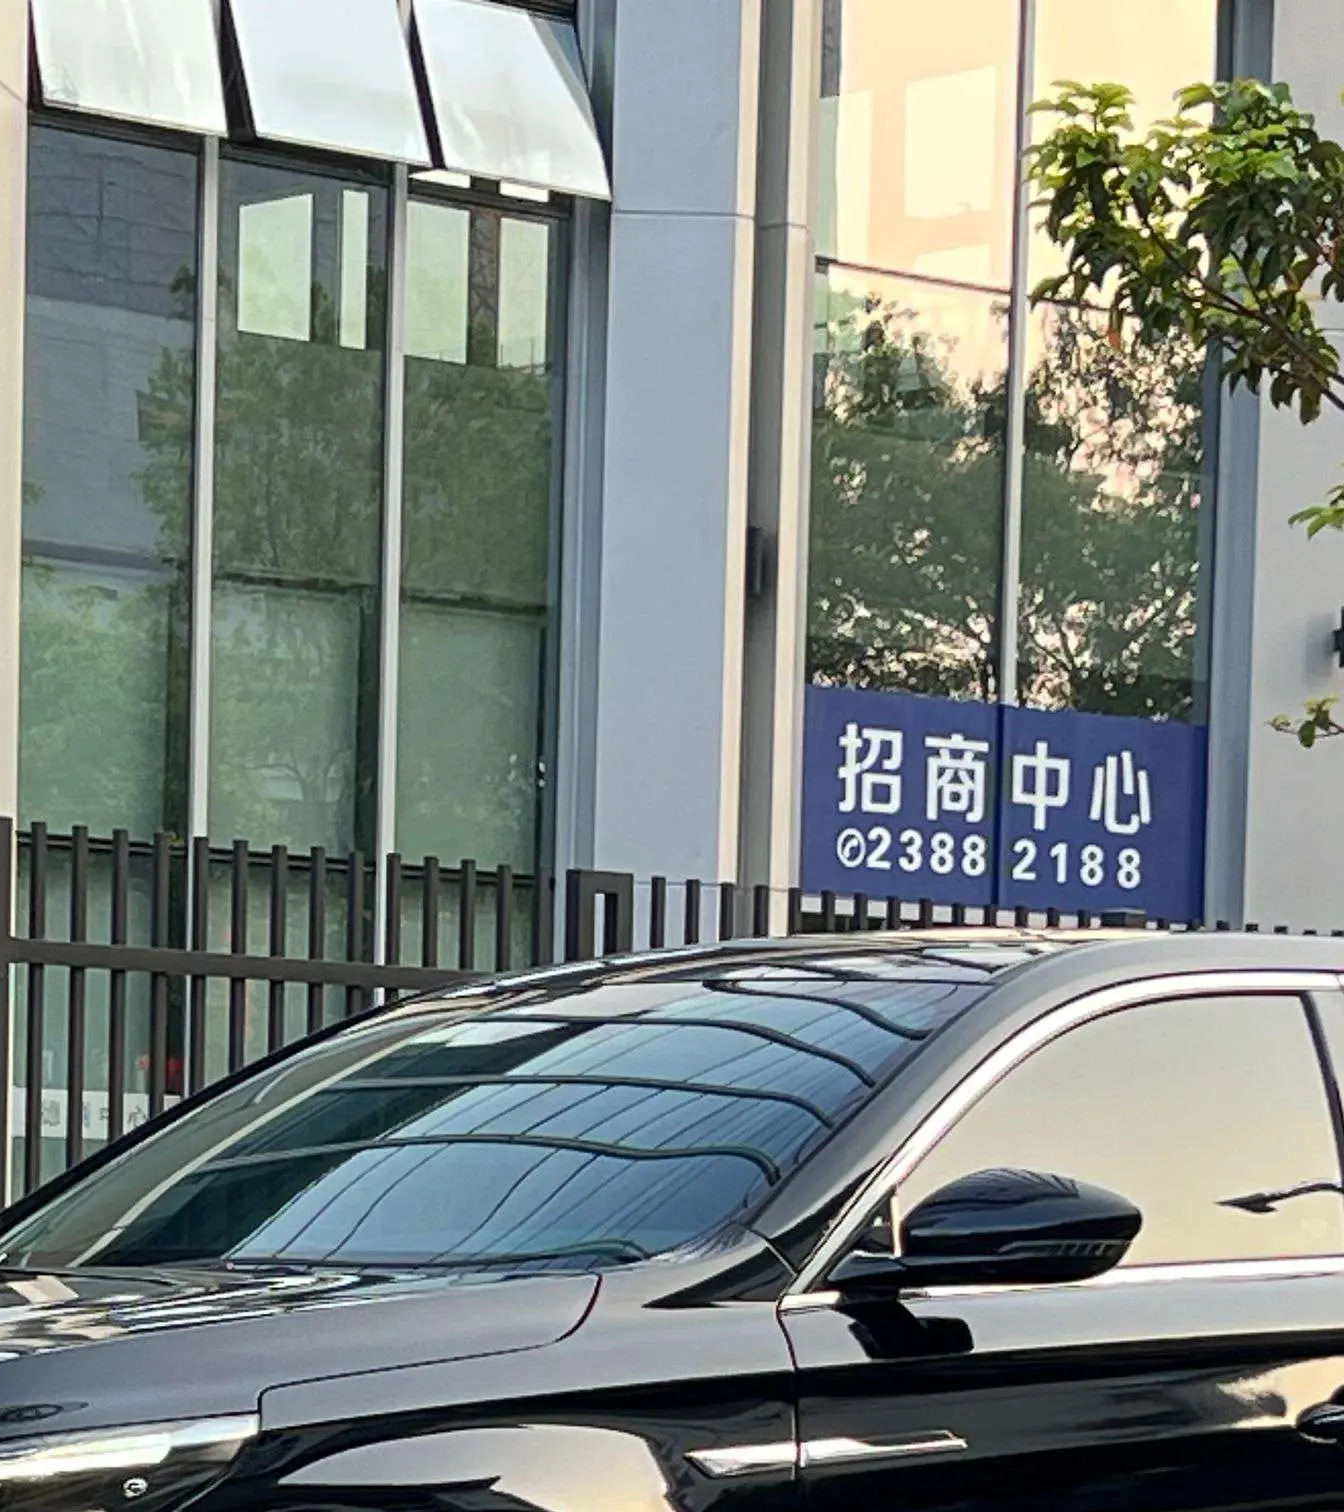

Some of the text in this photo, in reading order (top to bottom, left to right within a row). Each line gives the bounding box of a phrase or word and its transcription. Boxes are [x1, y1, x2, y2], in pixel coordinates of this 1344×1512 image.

[836, 721, 1152, 836] 招商中心
[865, 826, 1143, 890] 2388 2188
